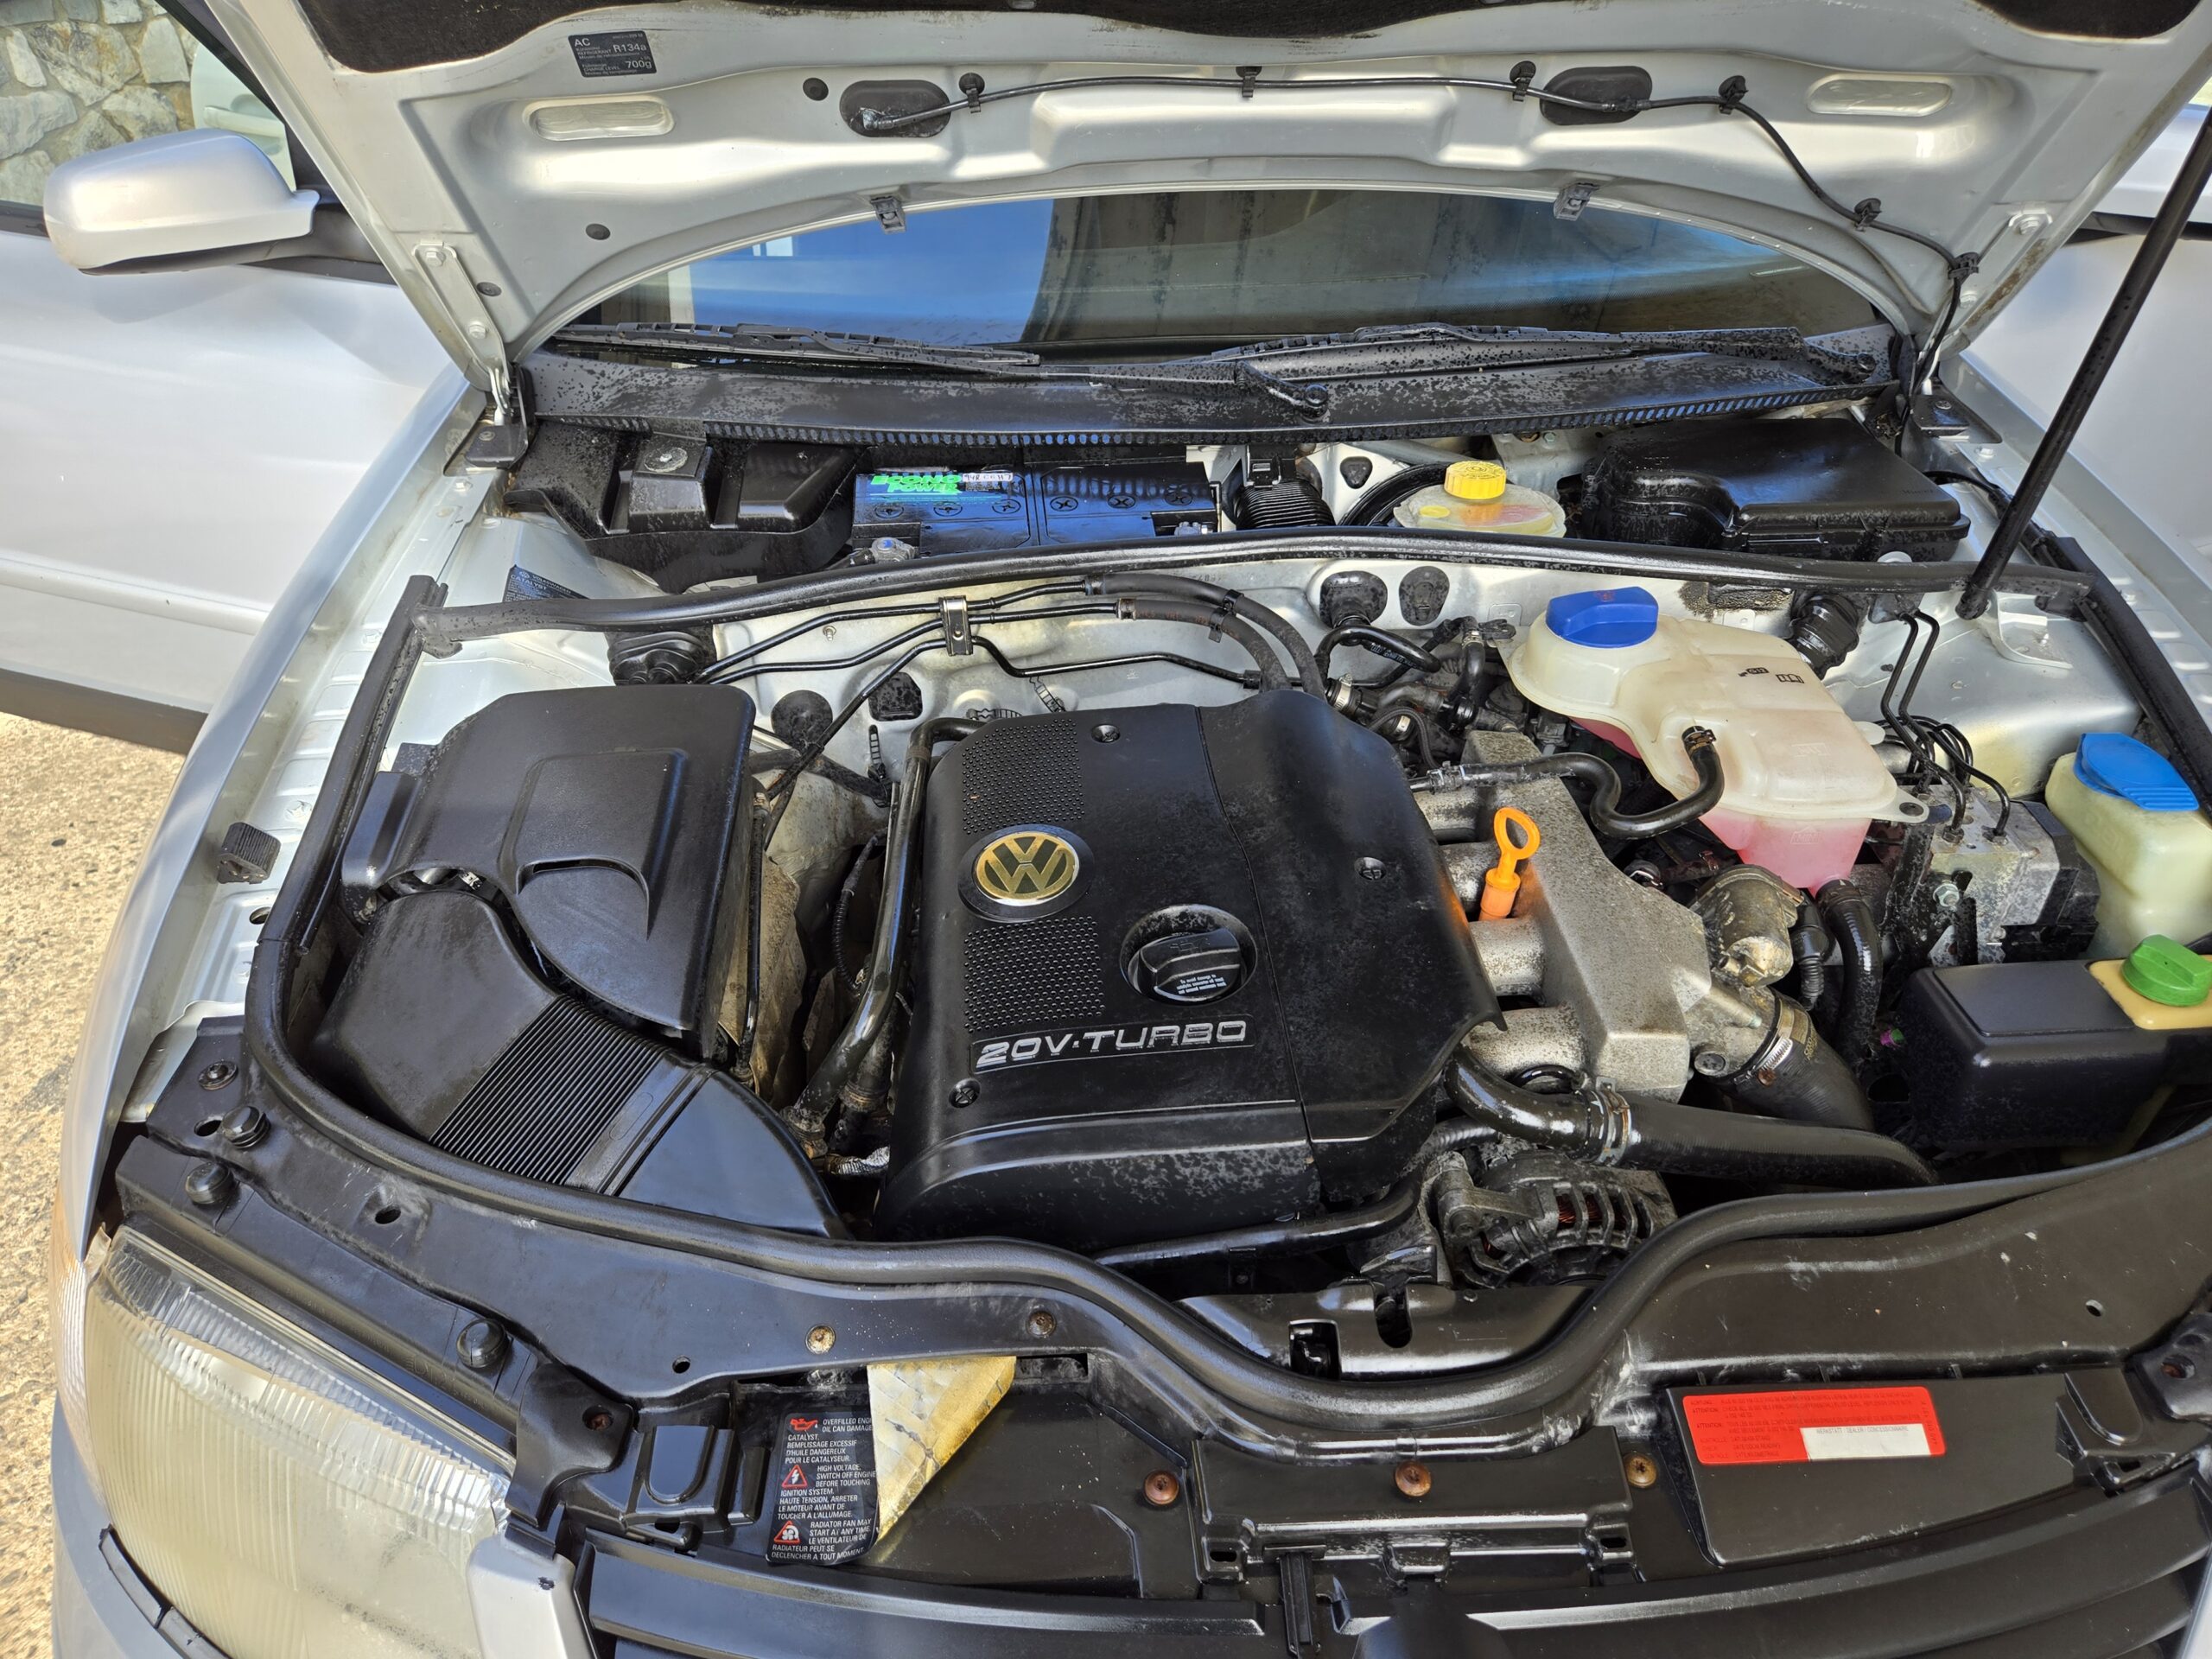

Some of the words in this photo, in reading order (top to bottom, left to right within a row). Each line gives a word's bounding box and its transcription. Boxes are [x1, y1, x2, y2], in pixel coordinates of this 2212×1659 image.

[575, 37, 591, 47] AC
[613, 43, 647, 53] R134a
[625, 60, 652, 69] 700g
[871, 474, 962, 485] ECONO
[887, 483, 961, 493] POWER
[511, 574, 547, 590] CATALYST
[817, 1535, 858, 1544] VENTILATEUR
[771, 1552, 812, 1560] DECLENCHER
